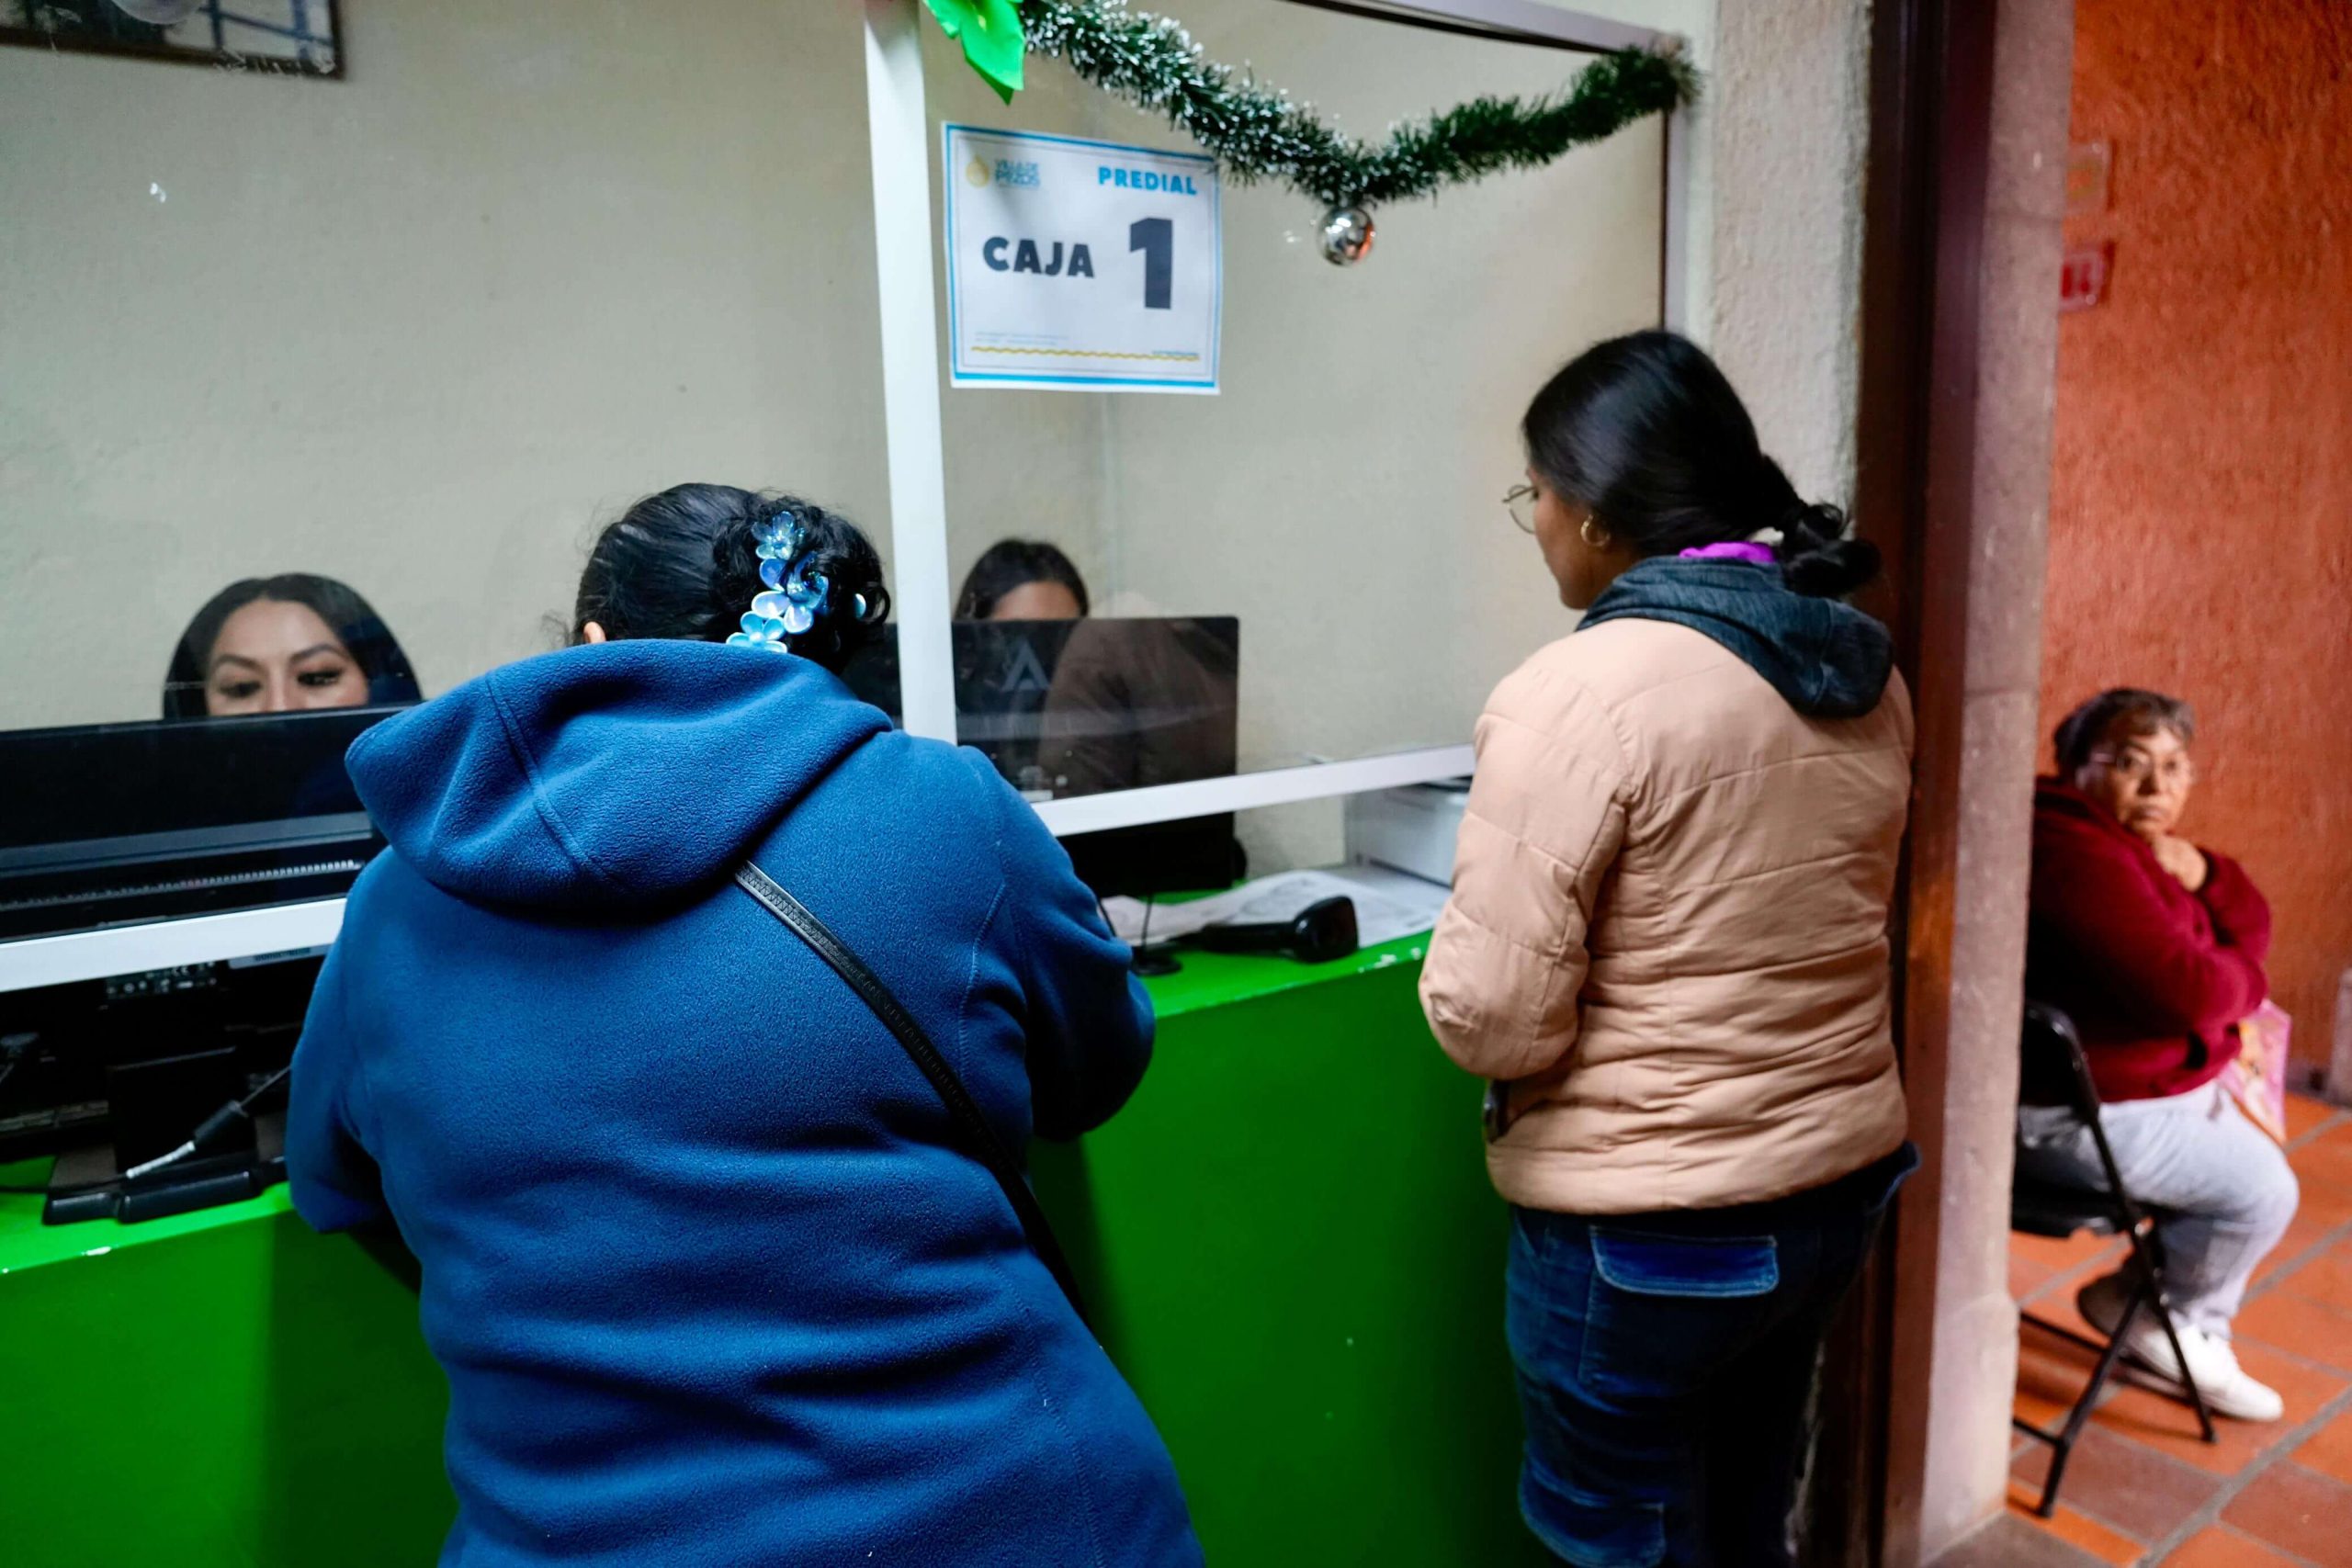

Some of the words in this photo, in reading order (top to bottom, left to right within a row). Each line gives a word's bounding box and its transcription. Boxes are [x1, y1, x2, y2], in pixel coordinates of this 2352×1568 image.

[1098, 166, 1197, 195] PREDIAL
[982, 236, 1094, 278] CAJA
[1129, 217, 1173, 310] 1
